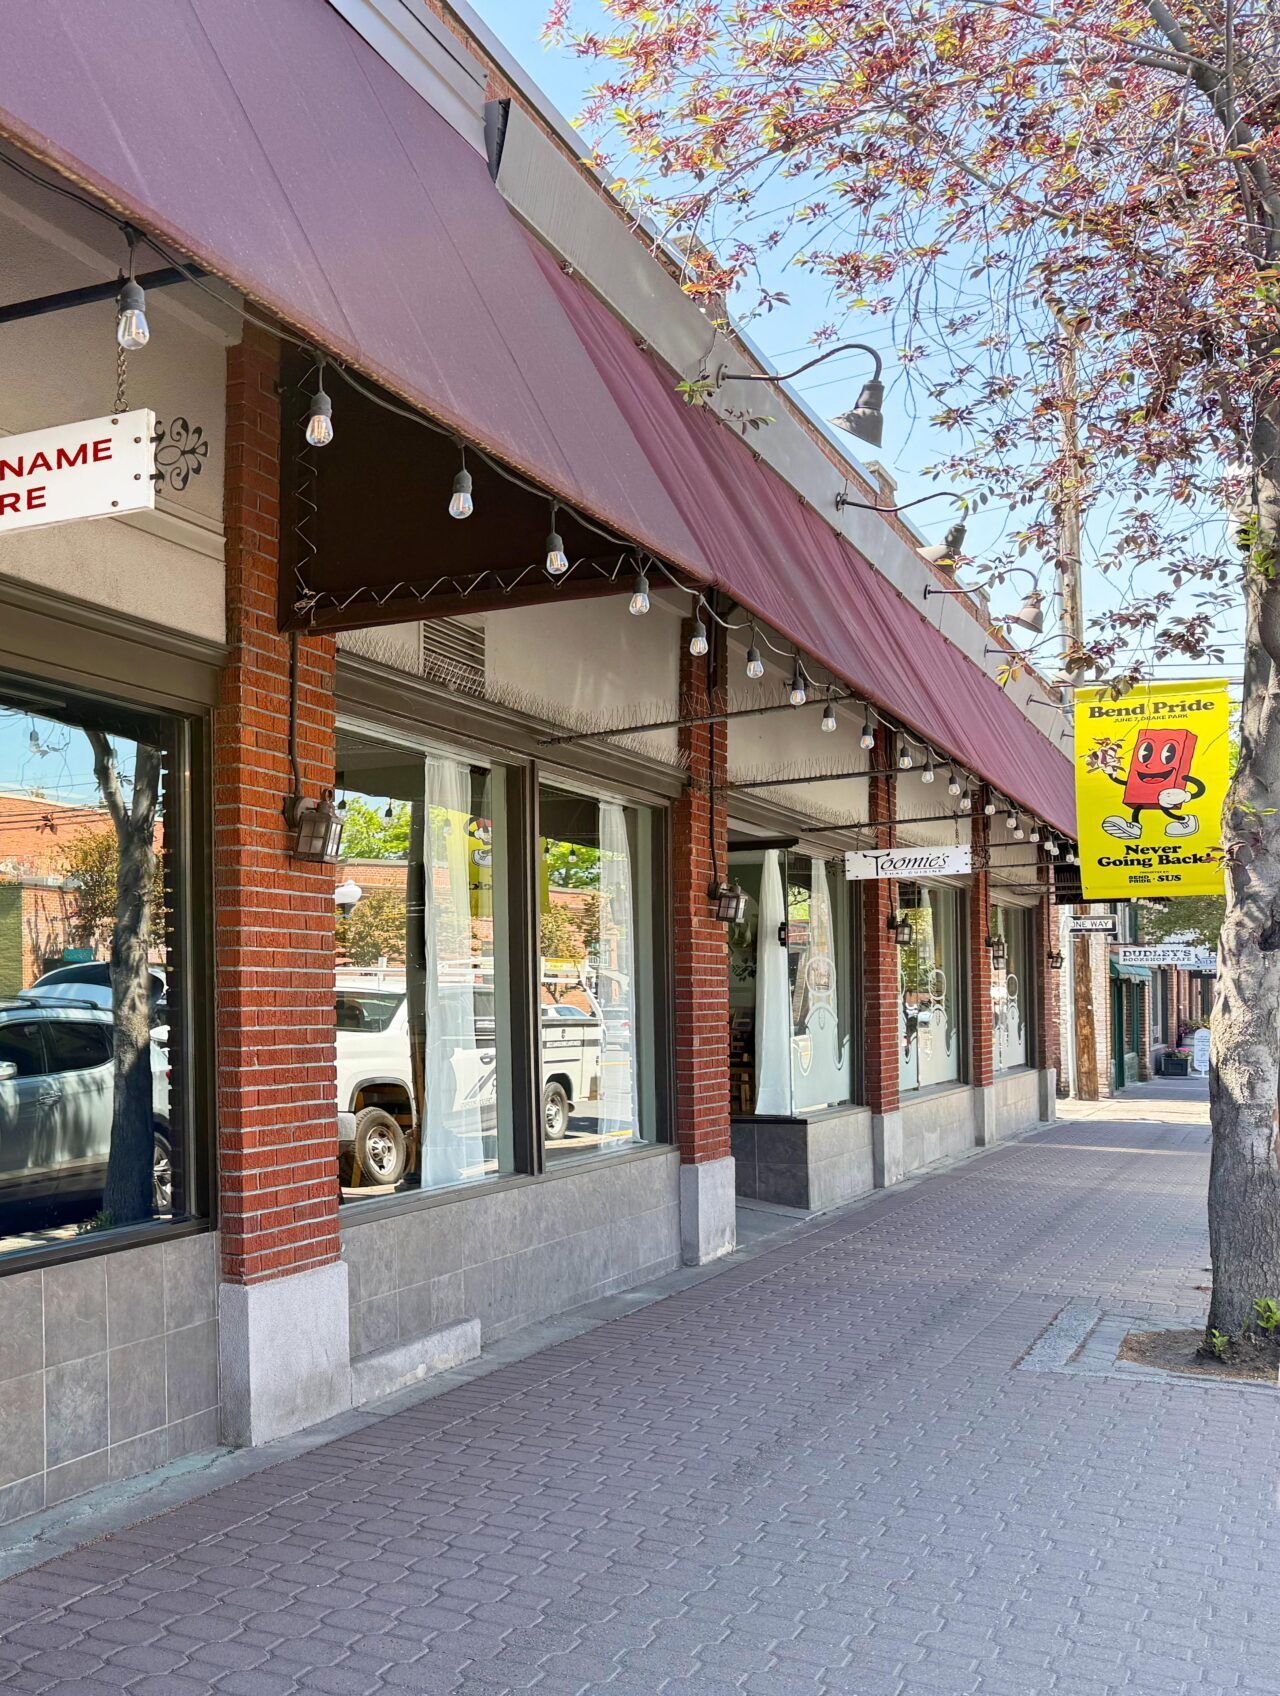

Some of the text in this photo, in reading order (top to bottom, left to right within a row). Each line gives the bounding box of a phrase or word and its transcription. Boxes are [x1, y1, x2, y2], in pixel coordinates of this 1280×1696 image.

[0, 438, 113, 481] NAME
[1088, 699, 1215, 719] Bend Pride
[1124, 844, 1182, 855] Never
[863, 850, 950, 876] Toomie's
[1097, 856, 1153, 868] Going
[1157, 874, 1182, 882] SUS
[1090, 920, 1110, 928] WAY
[1122, 949, 1192, 958] DUDLEY'S
